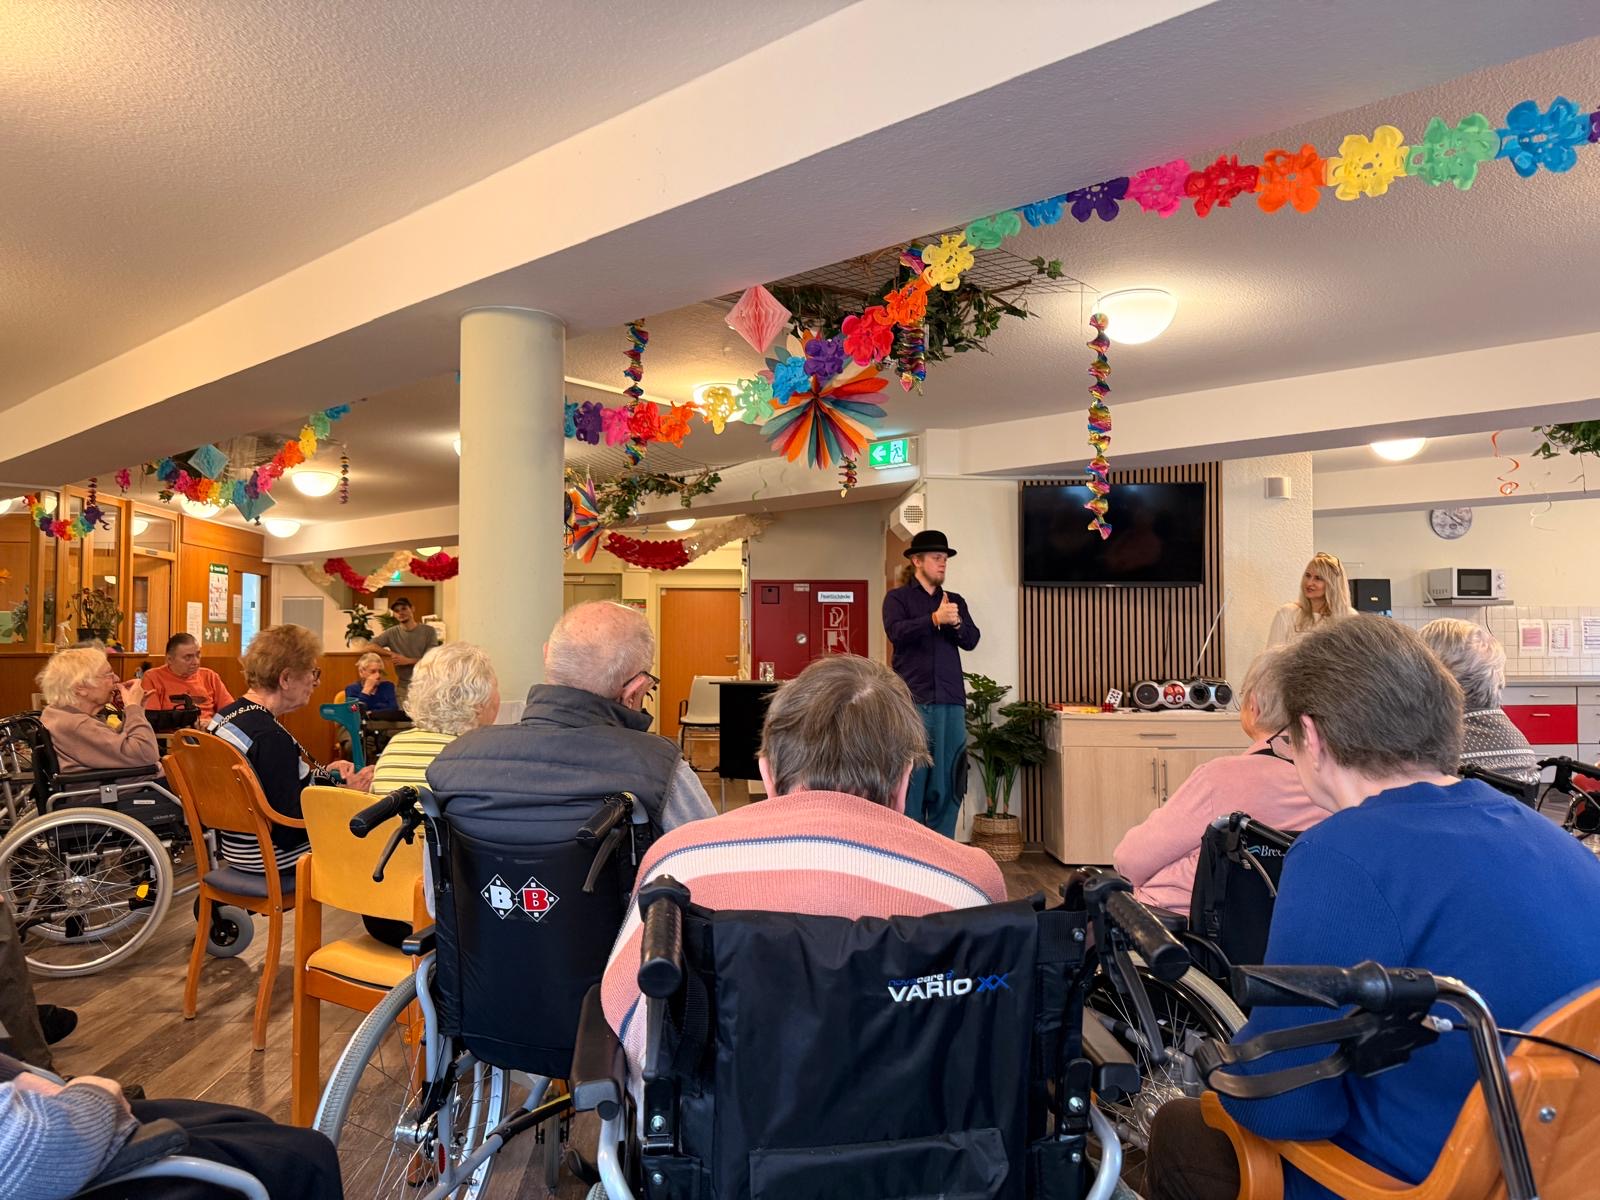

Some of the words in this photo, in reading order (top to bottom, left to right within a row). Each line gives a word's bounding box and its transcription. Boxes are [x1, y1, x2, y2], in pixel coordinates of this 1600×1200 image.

[1260, 845, 1286, 857] Bree
[888, 978, 972, 1002] VARIO
[976, 972, 1009, 992] XX
